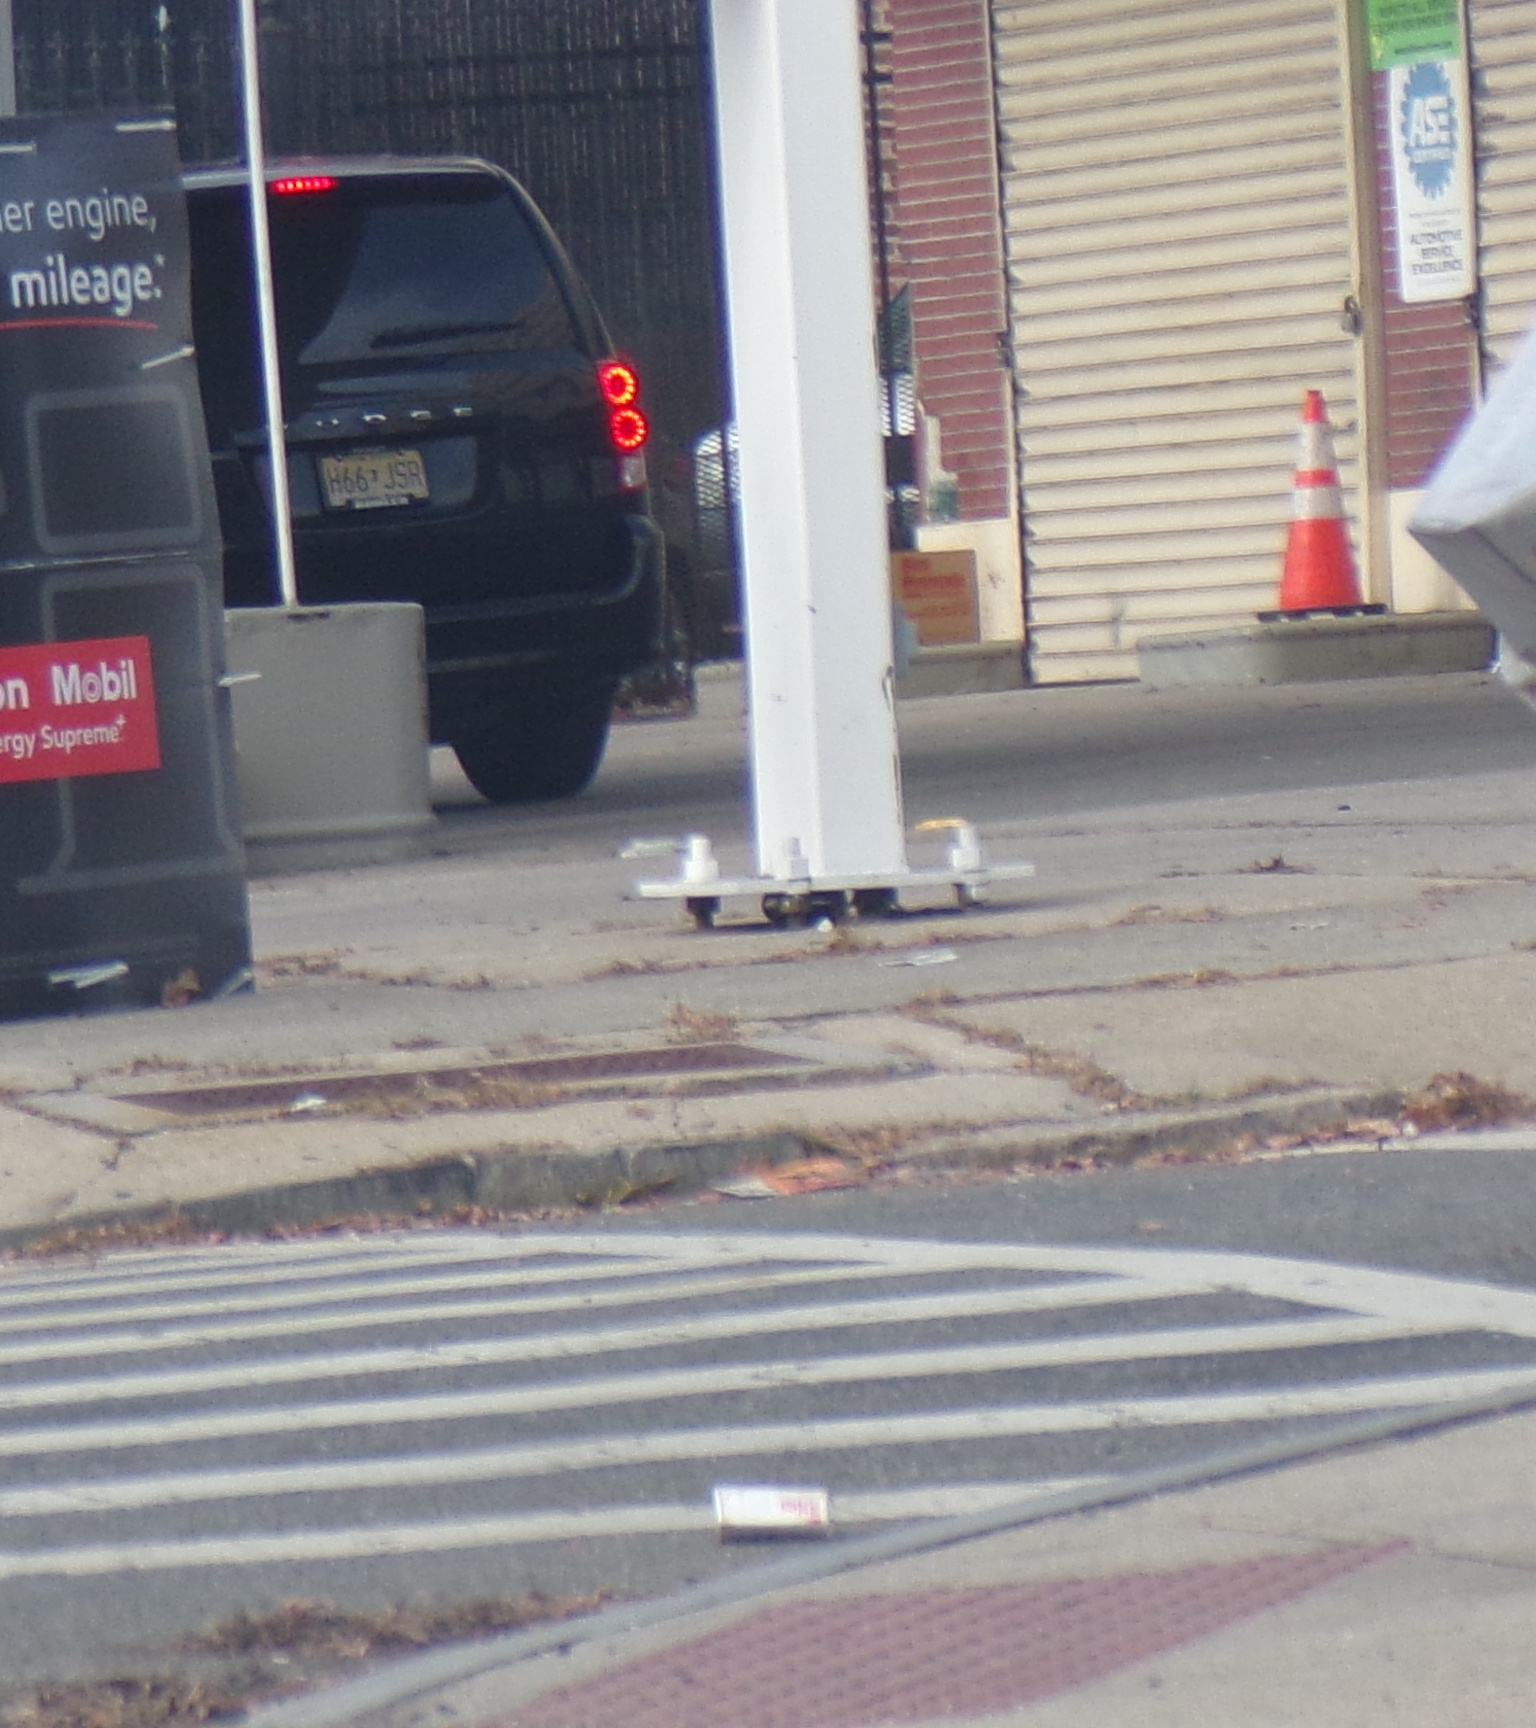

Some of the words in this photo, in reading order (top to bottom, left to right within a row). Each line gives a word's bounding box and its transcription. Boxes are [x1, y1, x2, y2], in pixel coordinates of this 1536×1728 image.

[1409, 96, 1450, 148] ASE
[45, 187, 157, 241] engine,
[50, 659, 137, 706] Mobil
